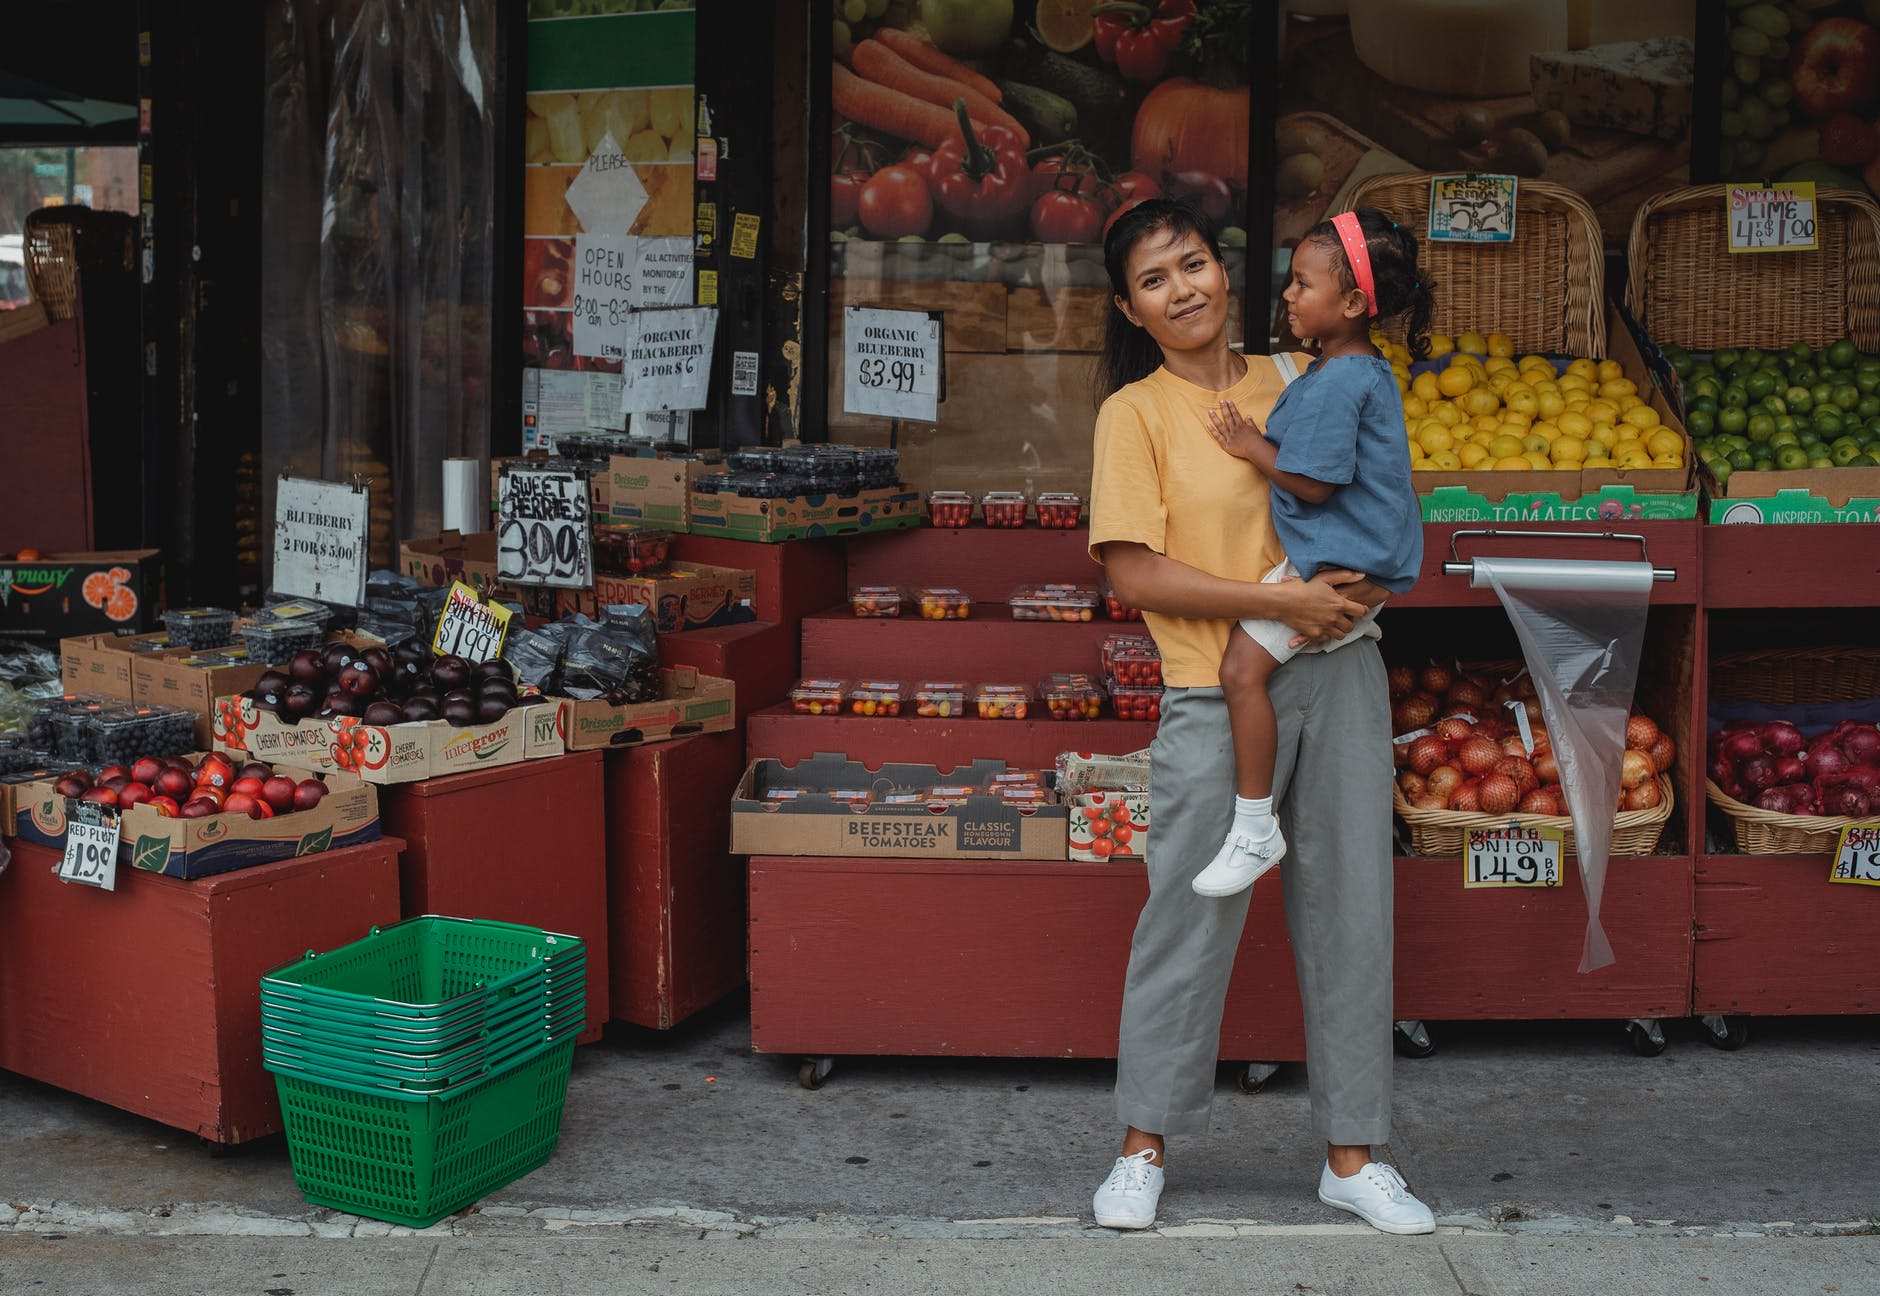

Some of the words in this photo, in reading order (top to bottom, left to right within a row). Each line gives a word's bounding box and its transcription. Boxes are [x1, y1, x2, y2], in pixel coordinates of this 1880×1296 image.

[590, 154, 628, 172] PLEASE
[1442, 180, 1499, 190] FRESH
[1442, 190, 1498, 200] LEMON
[1748, 201, 1797, 219] LIME
[585, 248, 624, 268] OPEN
[645, 254, 657, 263] ALL
[582, 268, 632, 291] HOURS
[643, 270, 685, 279] MONITORED
[643, 286, 652, 294] BY
[654, 286, 666, 294] THE
[644, 329, 694, 344] ORGANIC
[865, 327, 919, 342] ORGANIC
[632, 344, 705, 360] BLACKBERRY
[857, 342, 927, 359] BLUEBERRY
[642, 367, 649, 377] 2
[651, 364, 673, 377] FOR
[859, 359, 915, 393] $3.99
[510, 474, 574, 498] SWEET
[501, 495, 586, 522] CHERRIES
[286, 510, 354, 531] BLUEBERRY
[284, 538, 291, 551] 2
[293, 539, 318, 556] FOR
[256, 733, 281, 749] CHERRY
[282, 728, 327, 747] TOMATOES
[534, 722, 556, 742] NY
[395, 742, 416, 754] CHERRY
[445, 725, 509, 760] intergrow
[390, 748, 425, 767] TOMATOES
[69, 825, 86, 836] RED
[849, 821, 949, 837] BEEFSTEAK
[862, 836, 936, 848] TOMATOES
[964, 837, 1011, 846] FLAVOUR
[1471, 840, 1543, 854] ONION
[1475, 855, 1538, 883] 1.49
[1545, 858, 1558, 887] BAG
